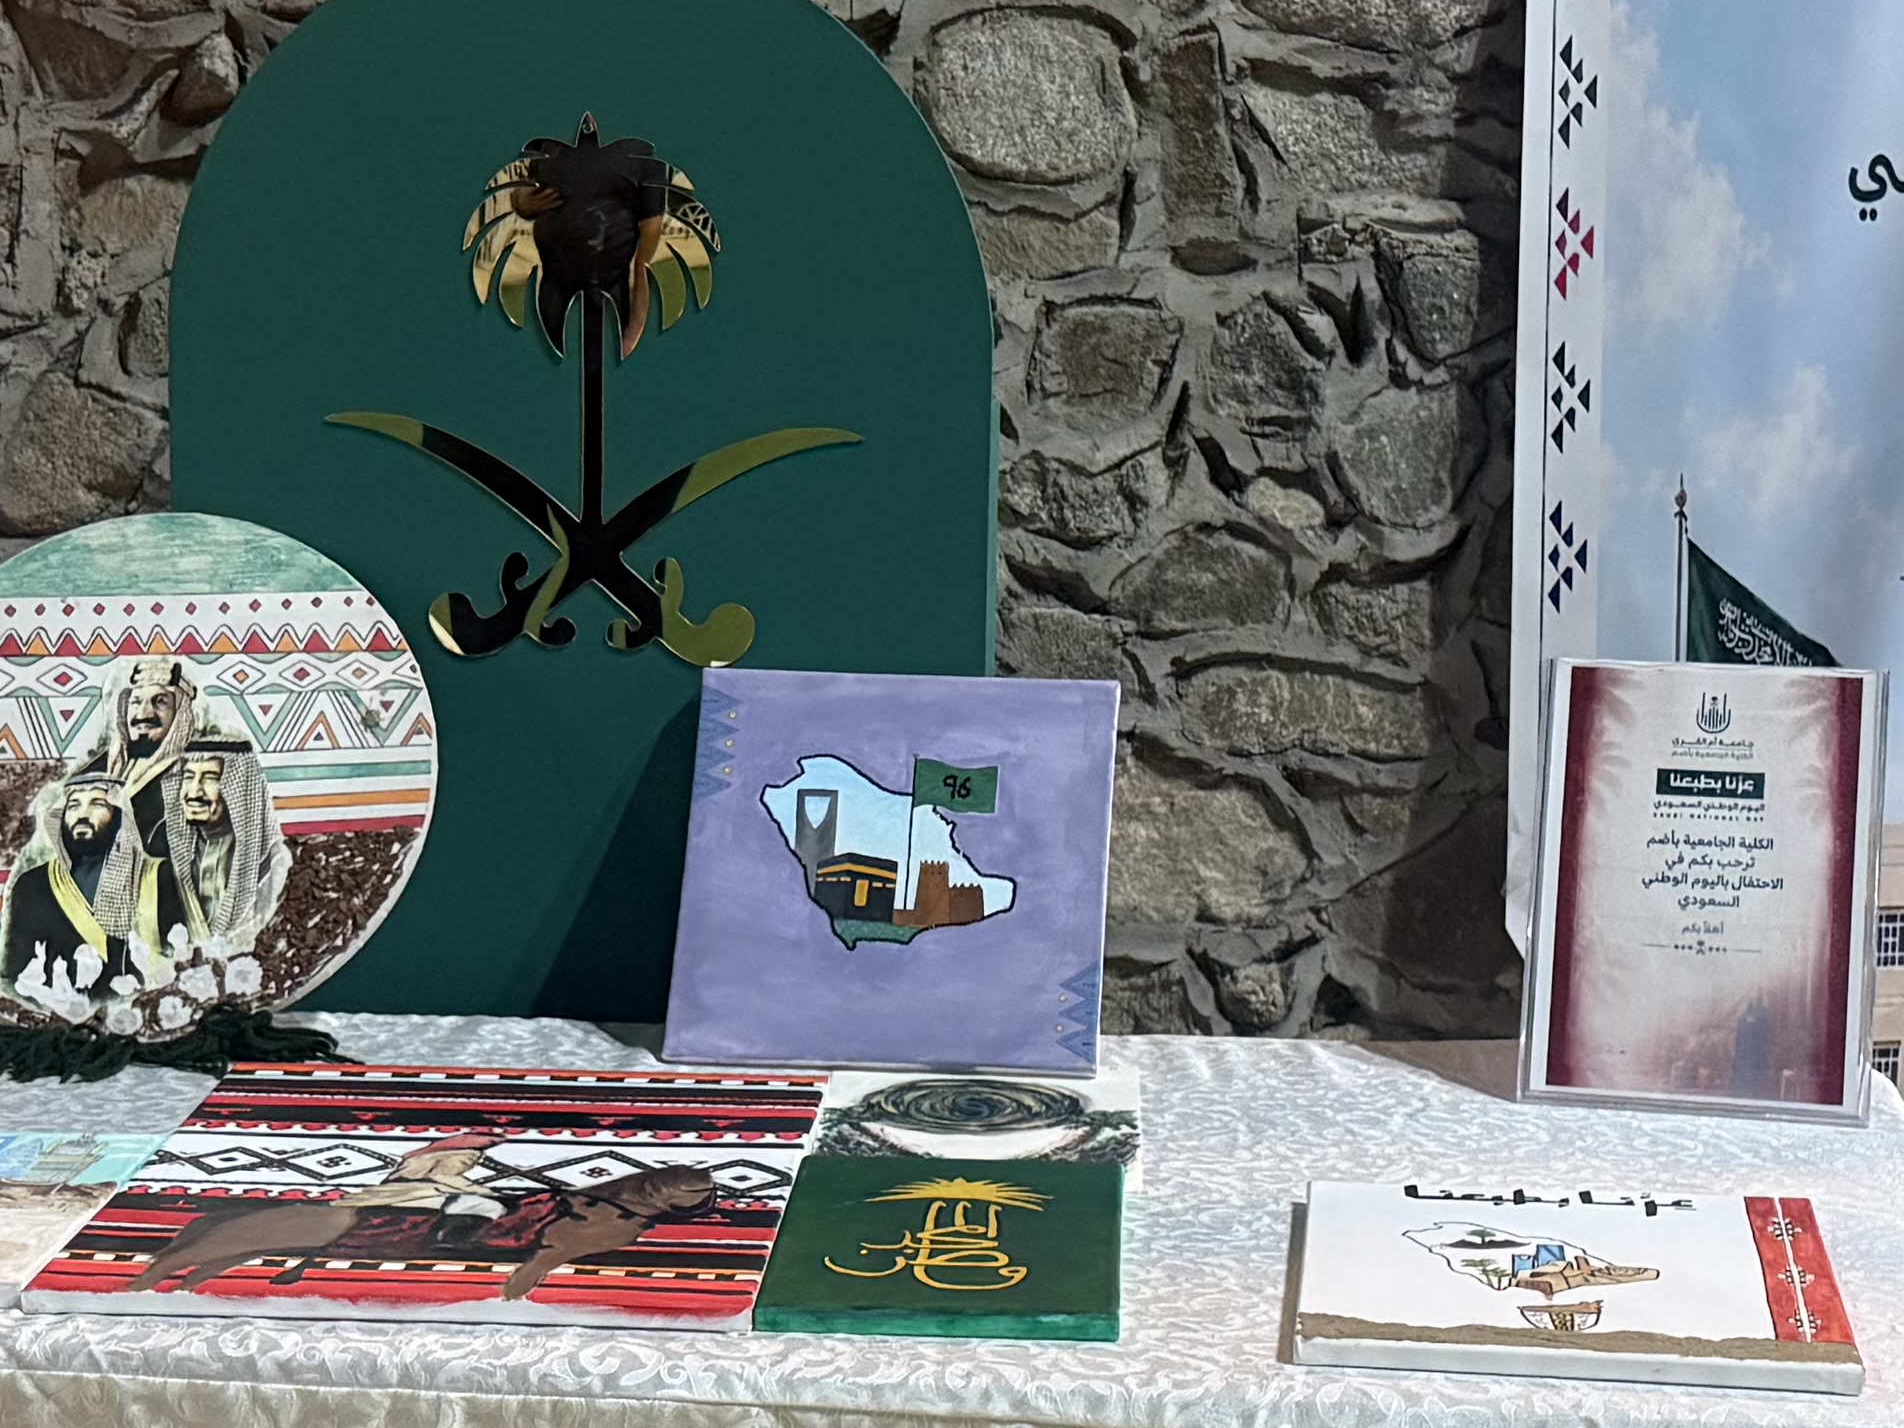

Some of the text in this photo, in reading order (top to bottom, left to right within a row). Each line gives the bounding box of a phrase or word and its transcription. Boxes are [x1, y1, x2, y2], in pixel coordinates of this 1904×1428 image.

[941, 773, 974, 802] 96
[1670, 772, 1722, 794] بطبعنا
[1683, 834, 1736, 851] الجامعية
[1739, 836, 1774, 852] الكلية
[1665, 851, 1756, 872] ترحب بكم في
[1642, 871, 1784, 891] الاحتفال باليوم الوطني
[1678, 895, 1740, 911] السعودي
